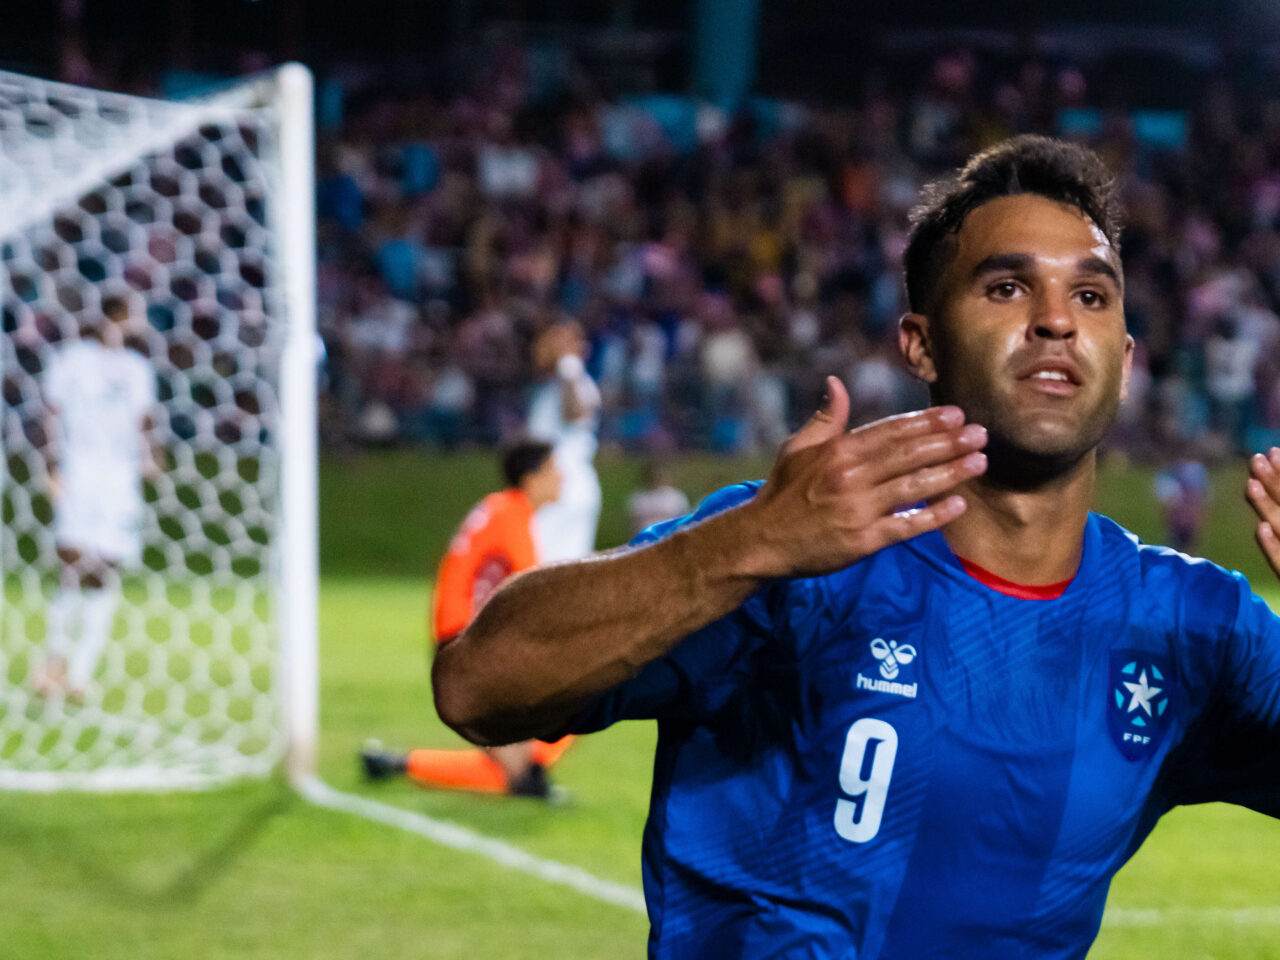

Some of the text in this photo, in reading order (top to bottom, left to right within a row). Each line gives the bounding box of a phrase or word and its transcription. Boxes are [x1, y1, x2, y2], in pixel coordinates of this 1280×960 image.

[856, 672, 918, 699] hummel
[1123, 732, 1151, 745] FPF
[833, 718, 899, 843] 9
